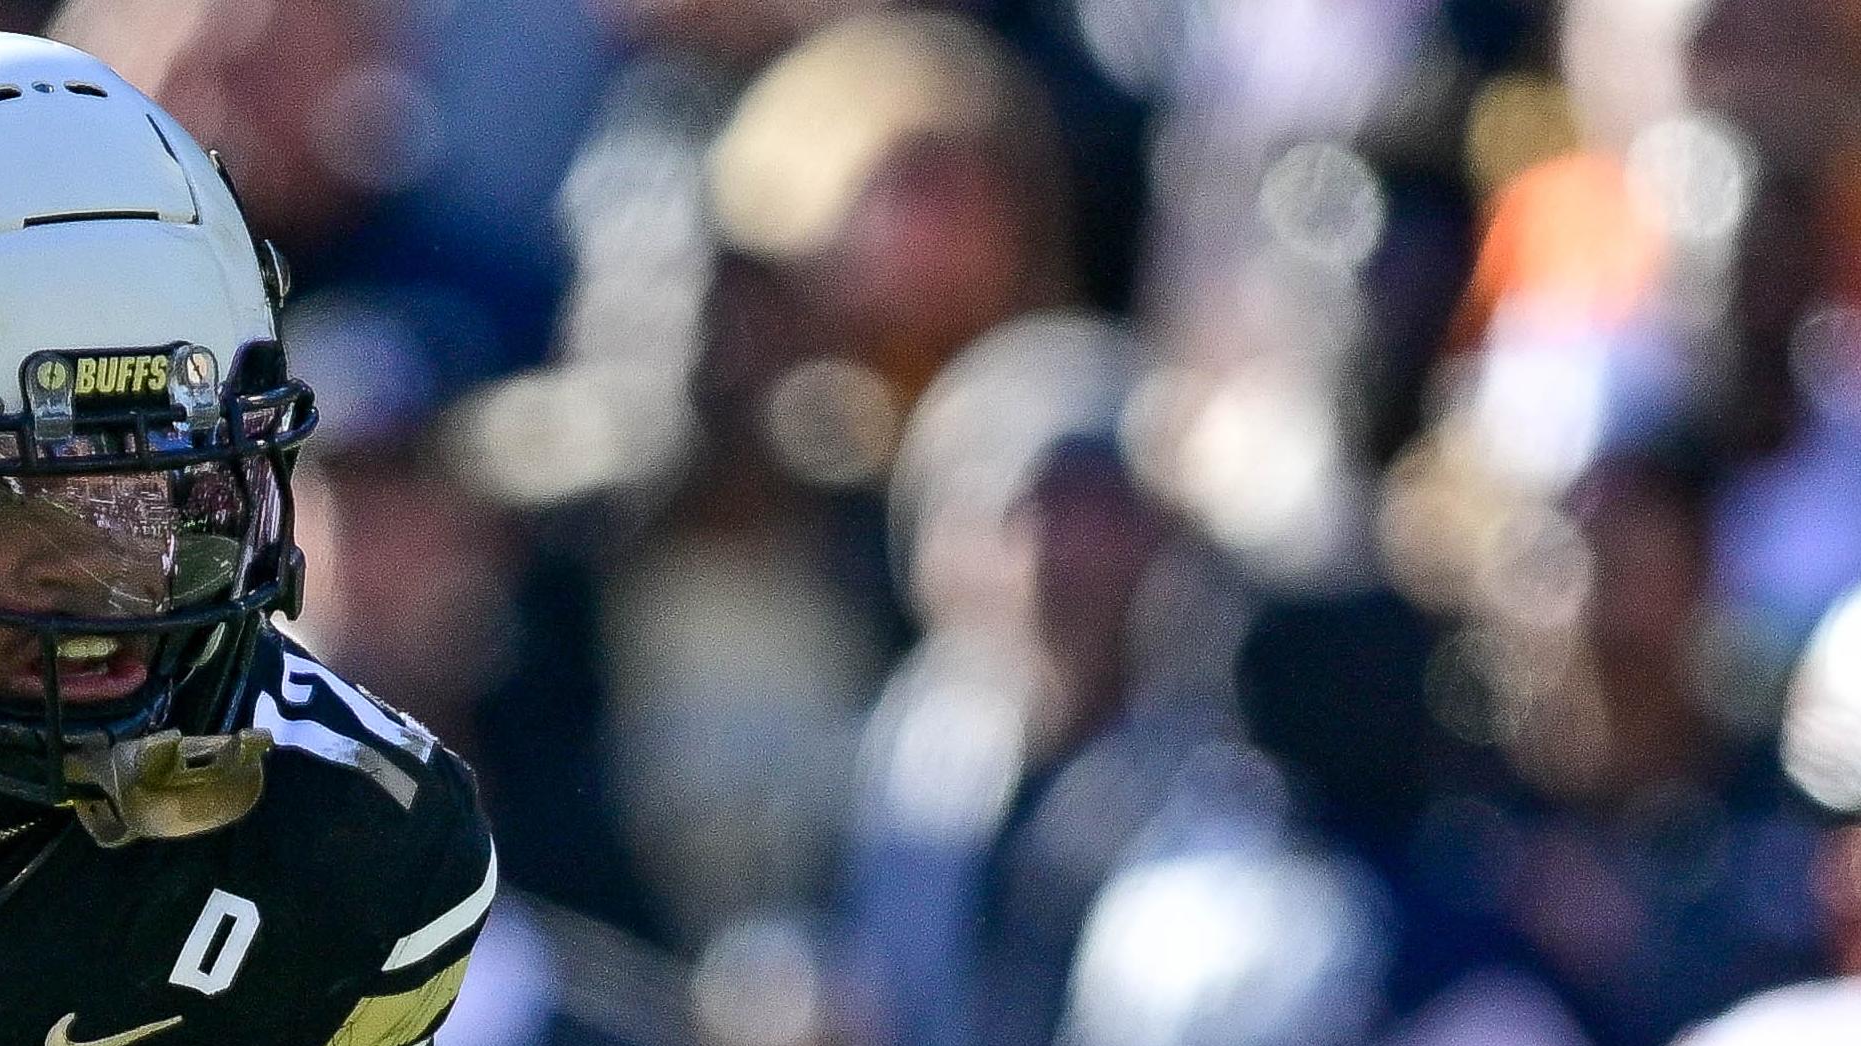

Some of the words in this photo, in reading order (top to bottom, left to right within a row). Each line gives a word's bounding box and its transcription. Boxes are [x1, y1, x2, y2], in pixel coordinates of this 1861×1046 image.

[76, 354, 168, 394] BUFFS
[254, 652, 435, 809] 12
[169, 888, 261, 995] D
